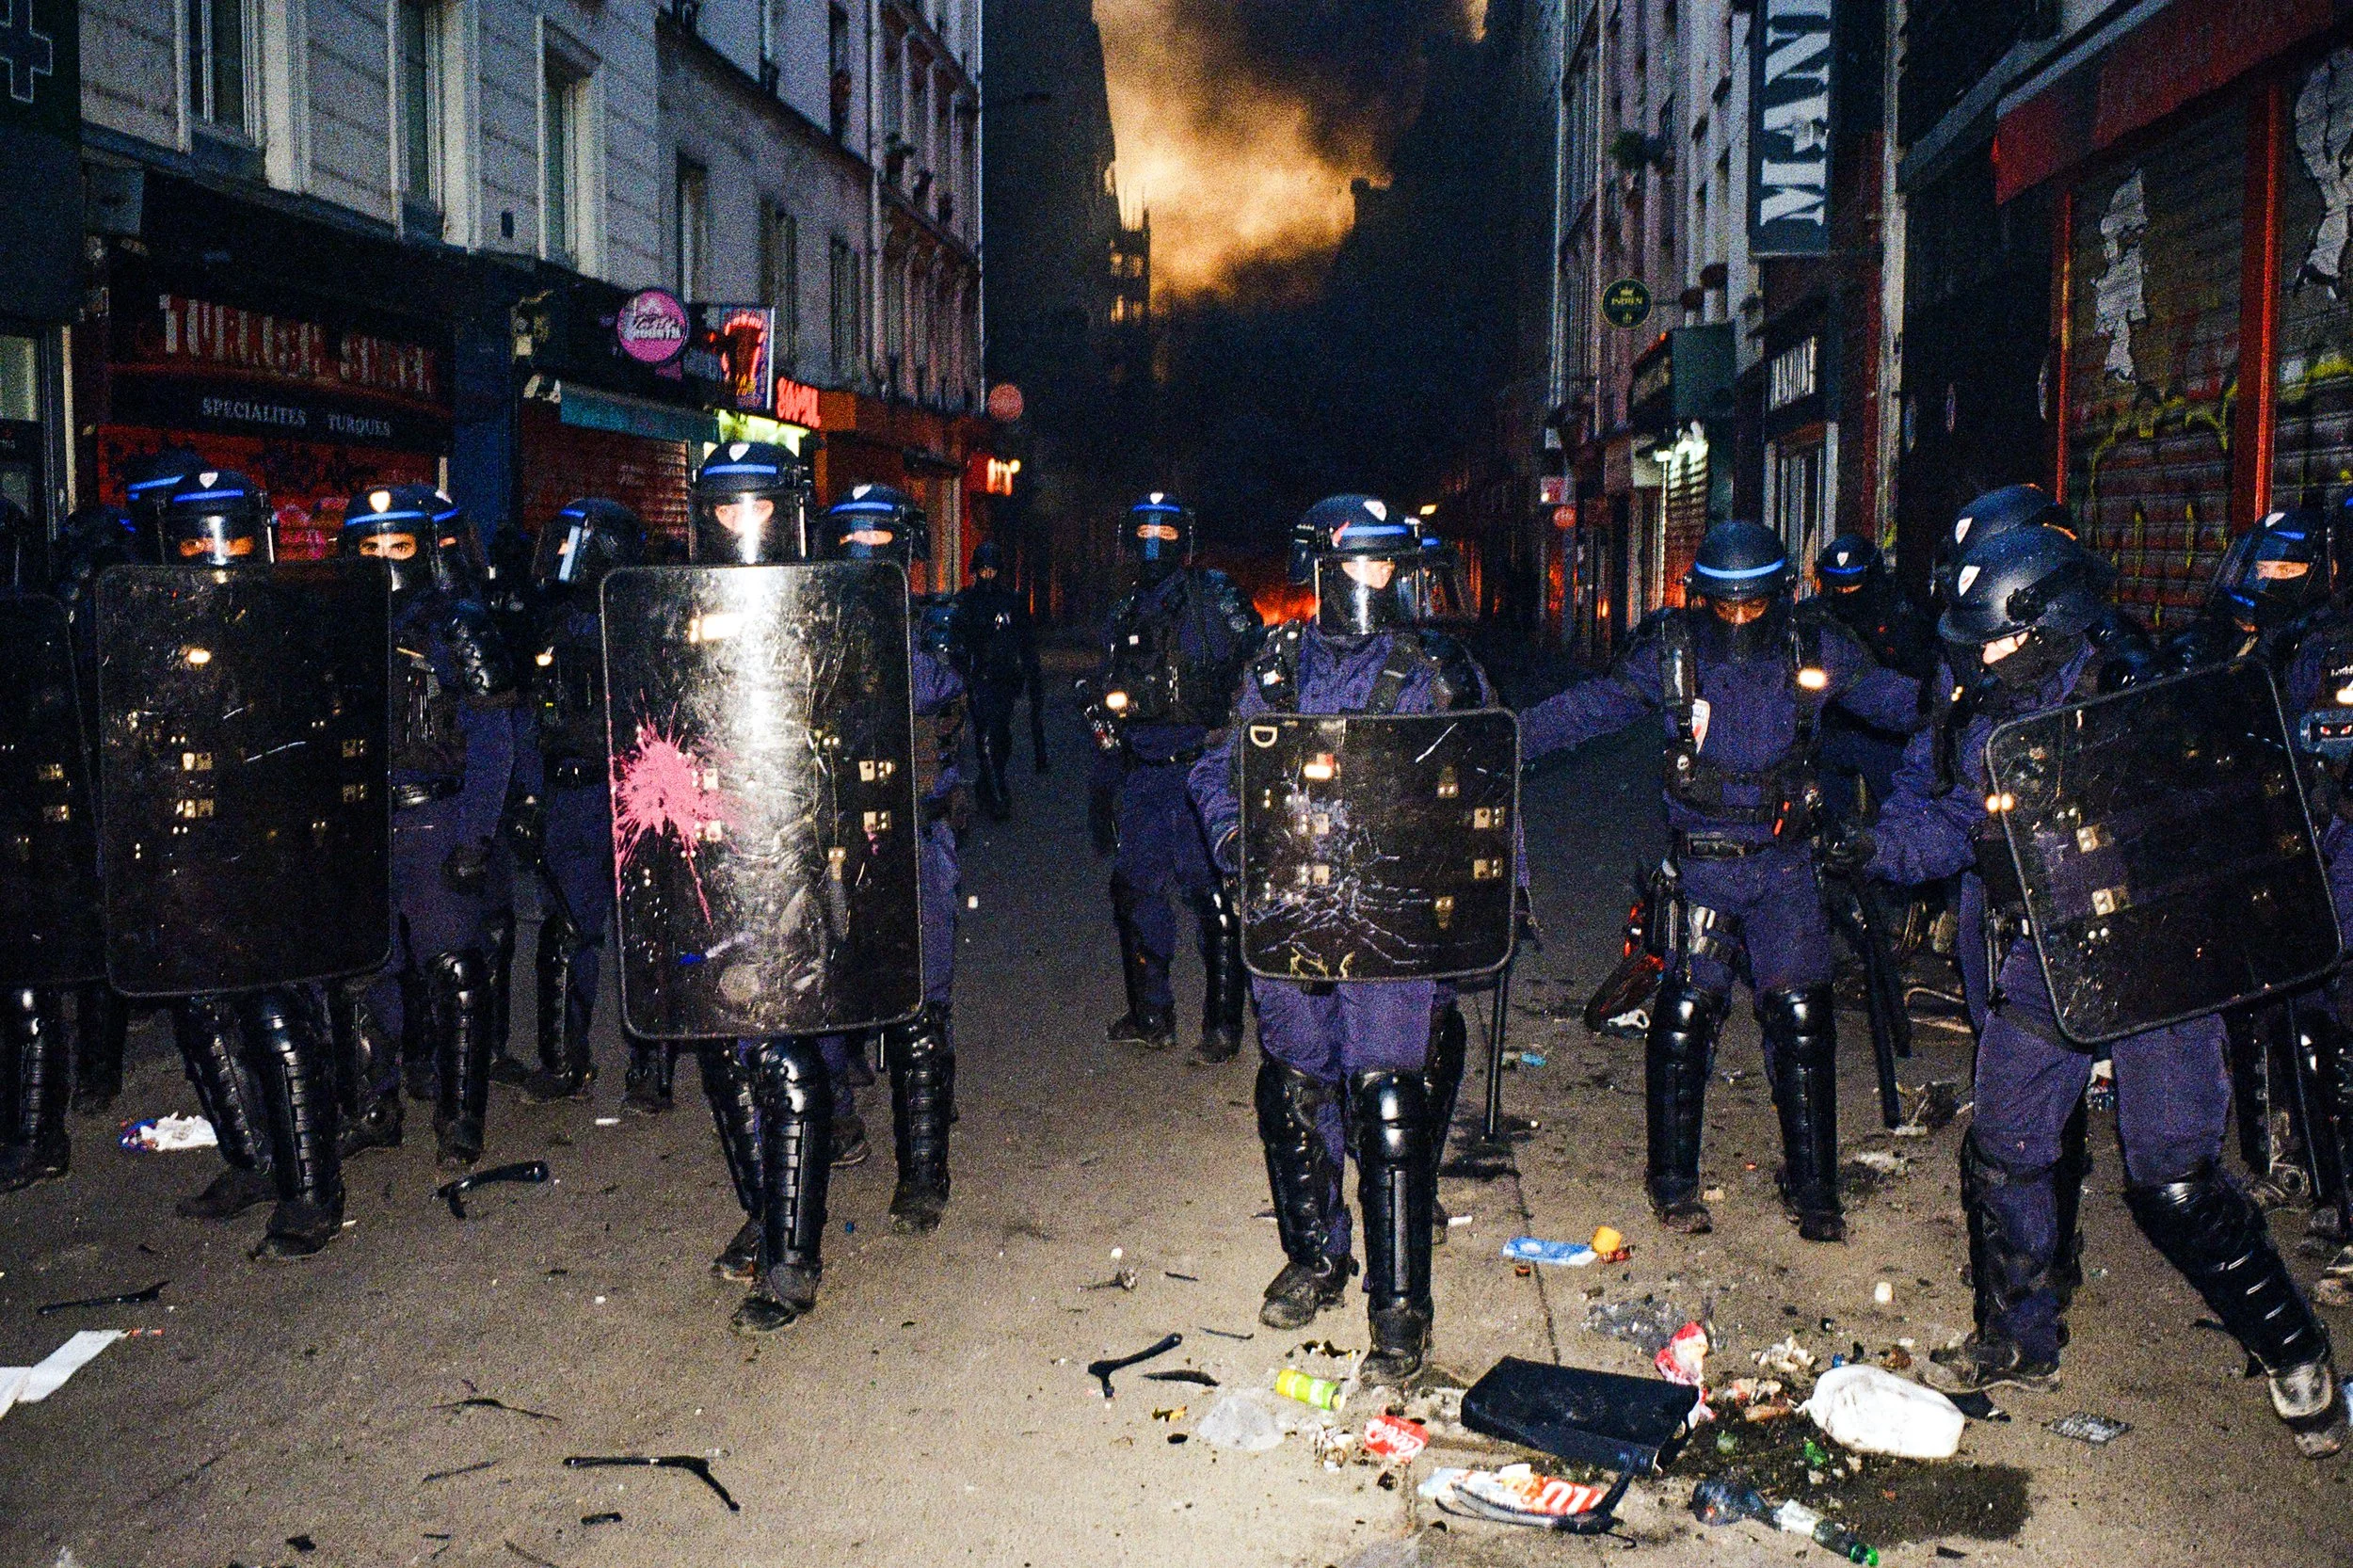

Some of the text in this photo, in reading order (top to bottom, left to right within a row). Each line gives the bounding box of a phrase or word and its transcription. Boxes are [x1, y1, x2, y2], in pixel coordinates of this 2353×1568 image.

[158, 294, 438, 395] TURKISH SNACK
[201, 396, 392, 439] SPECIALITES TURQUES
